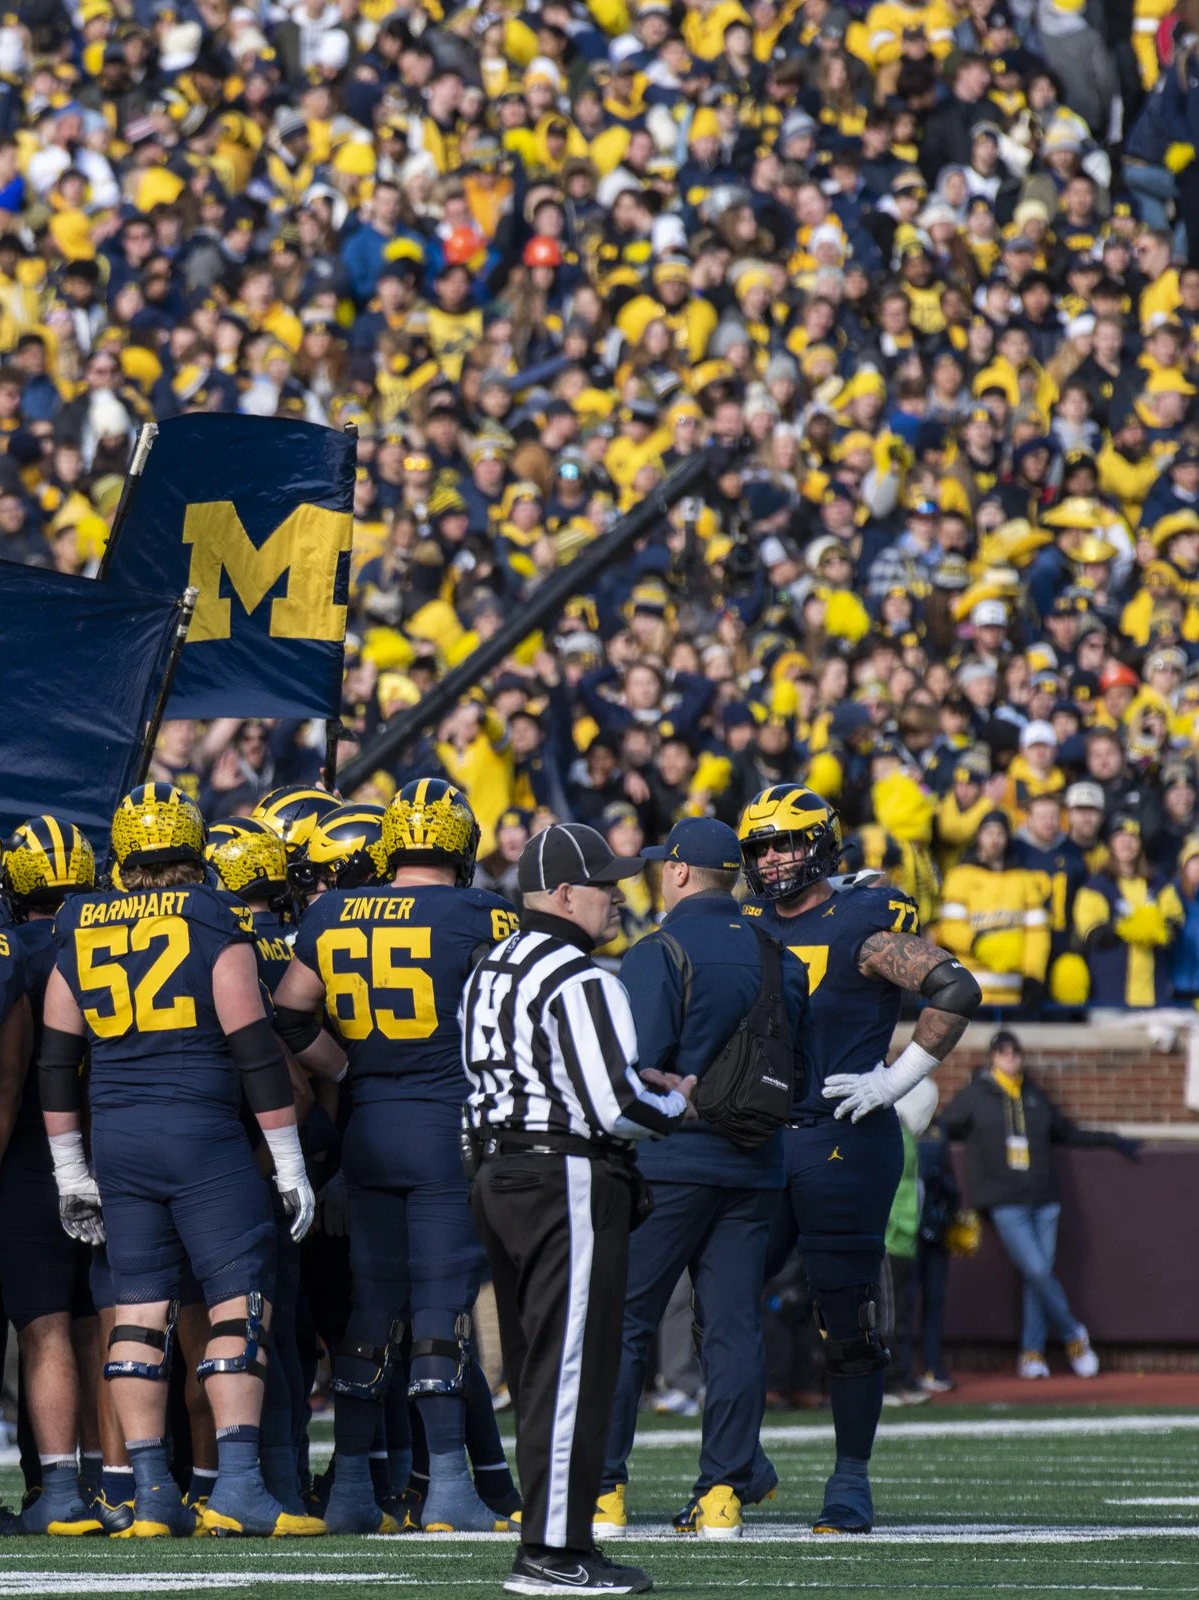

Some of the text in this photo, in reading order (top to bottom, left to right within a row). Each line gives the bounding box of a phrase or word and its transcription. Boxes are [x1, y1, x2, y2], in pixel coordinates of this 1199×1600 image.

[181, 500, 353, 643] M
[80, 891, 190, 928] BARNHART
[339, 896, 416, 922] ZINTER
[888, 900, 919, 934] 77
[74, 915, 198, 1039] 52
[317, 926, 439, 1040] 65
[470, 969, 514, 1063] H
